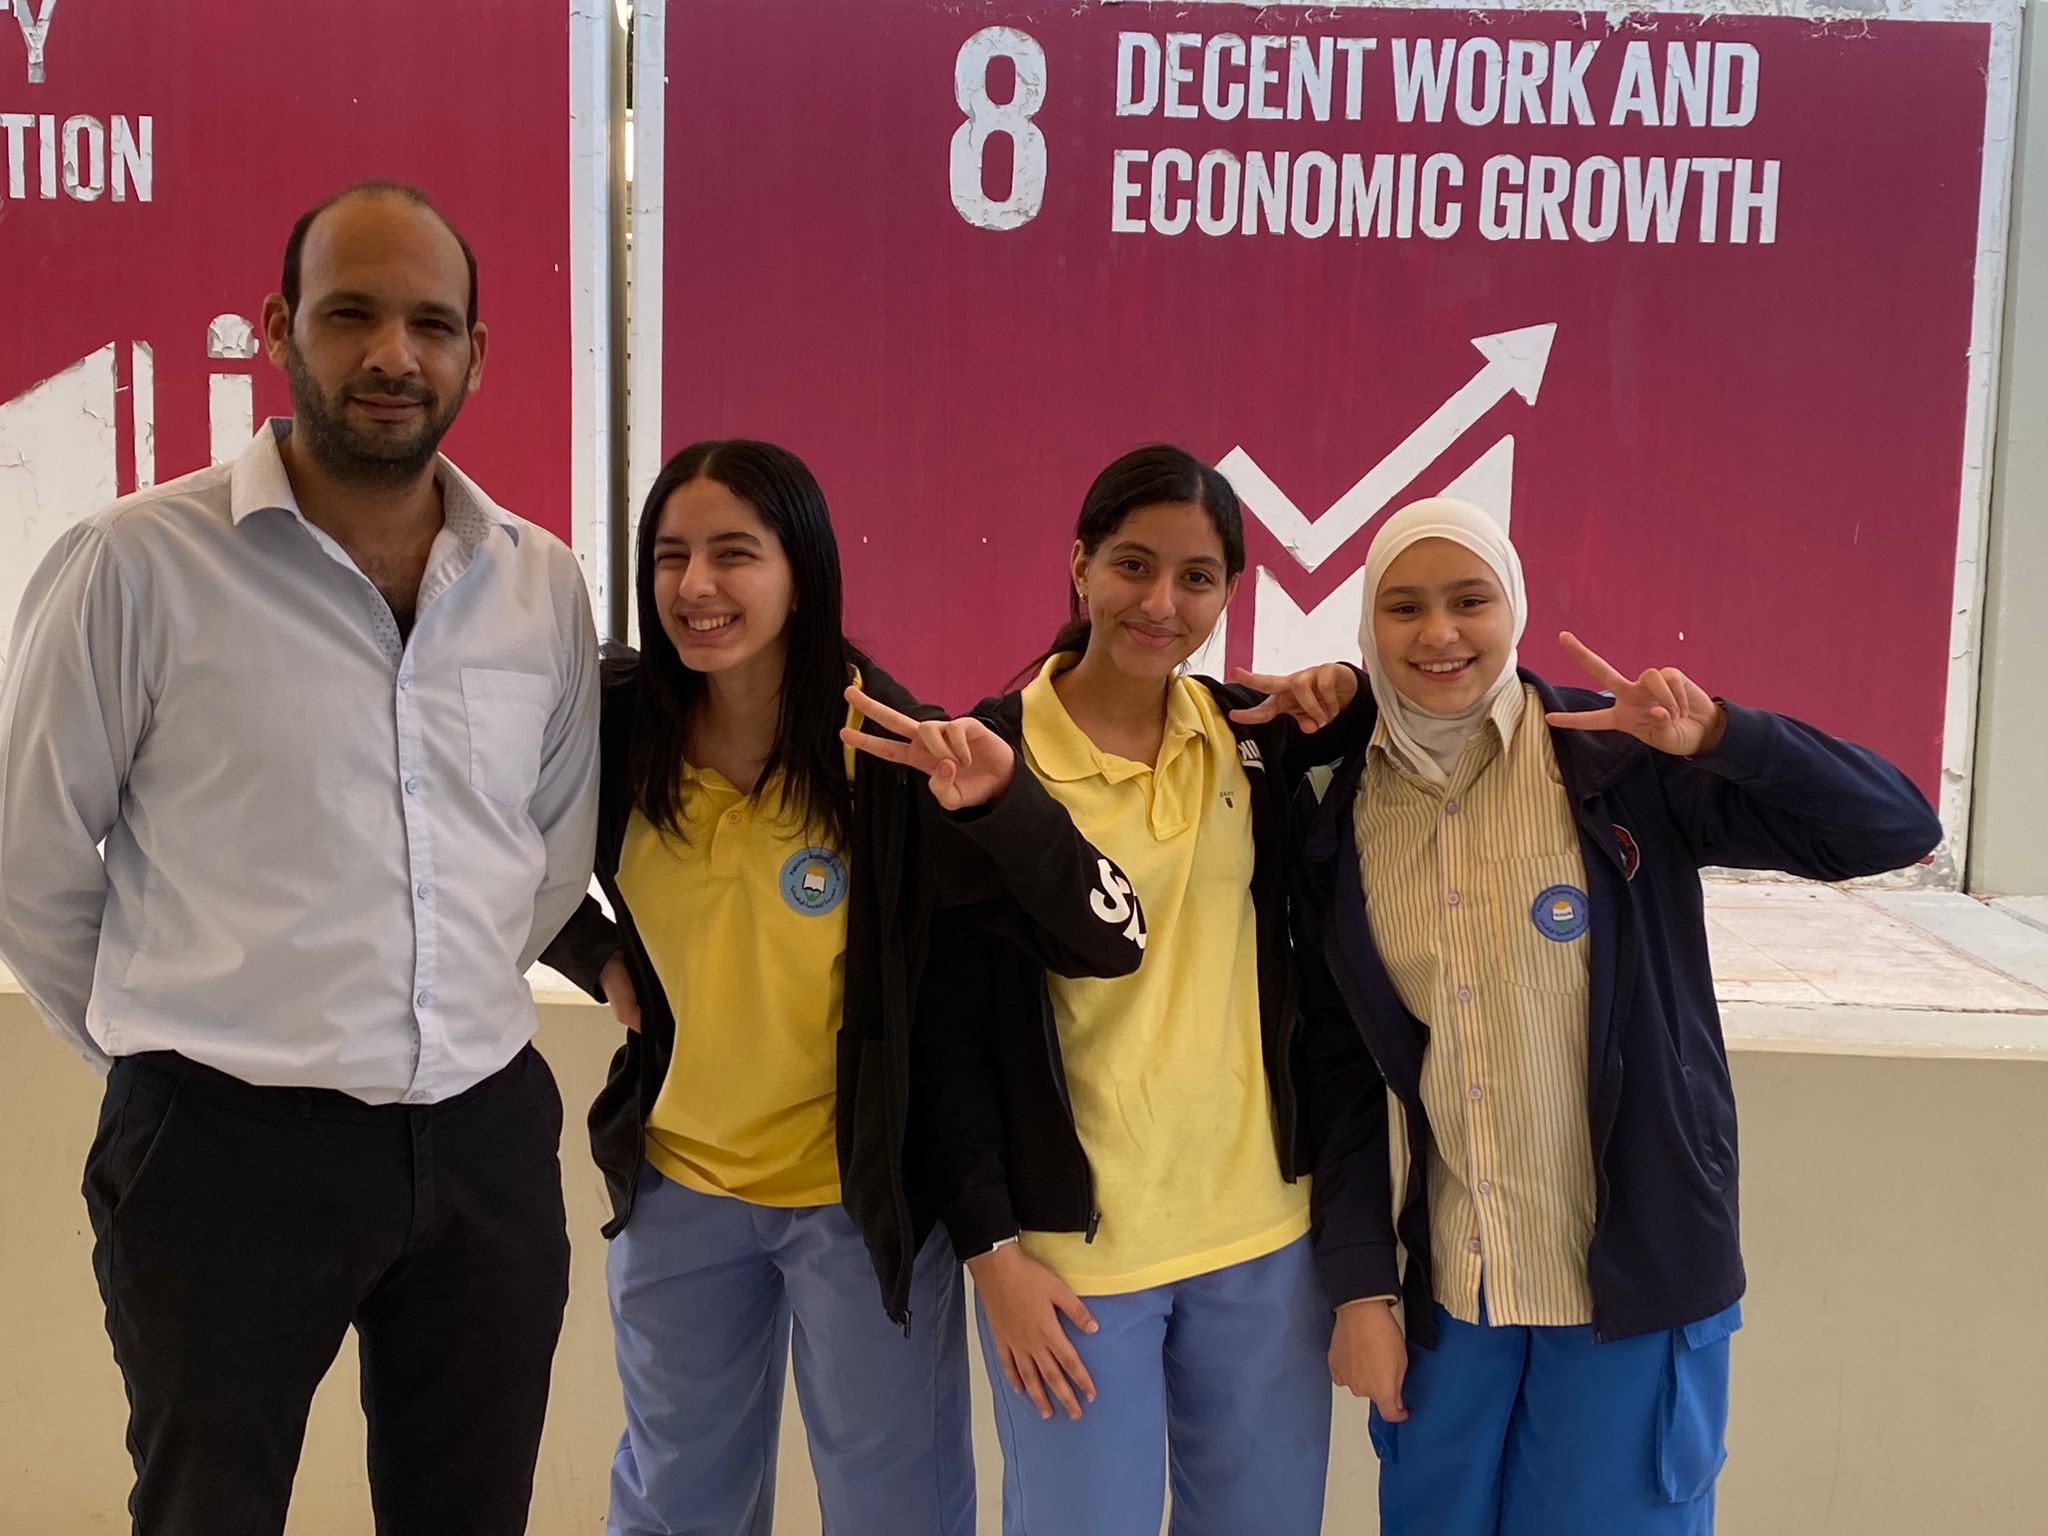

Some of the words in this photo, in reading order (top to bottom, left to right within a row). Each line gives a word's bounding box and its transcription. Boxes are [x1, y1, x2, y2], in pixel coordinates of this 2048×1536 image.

[1115, 31, 1377, 121] DECENT
[1391, 37, 1601, 126] WORK
[1610, 39, 1760, 127] AND
[950, 25, 1048, 231] 8
[1111, 147, 1464, 239] ECONOMIC
[1479, 153, 1781, 243] GROWTH
